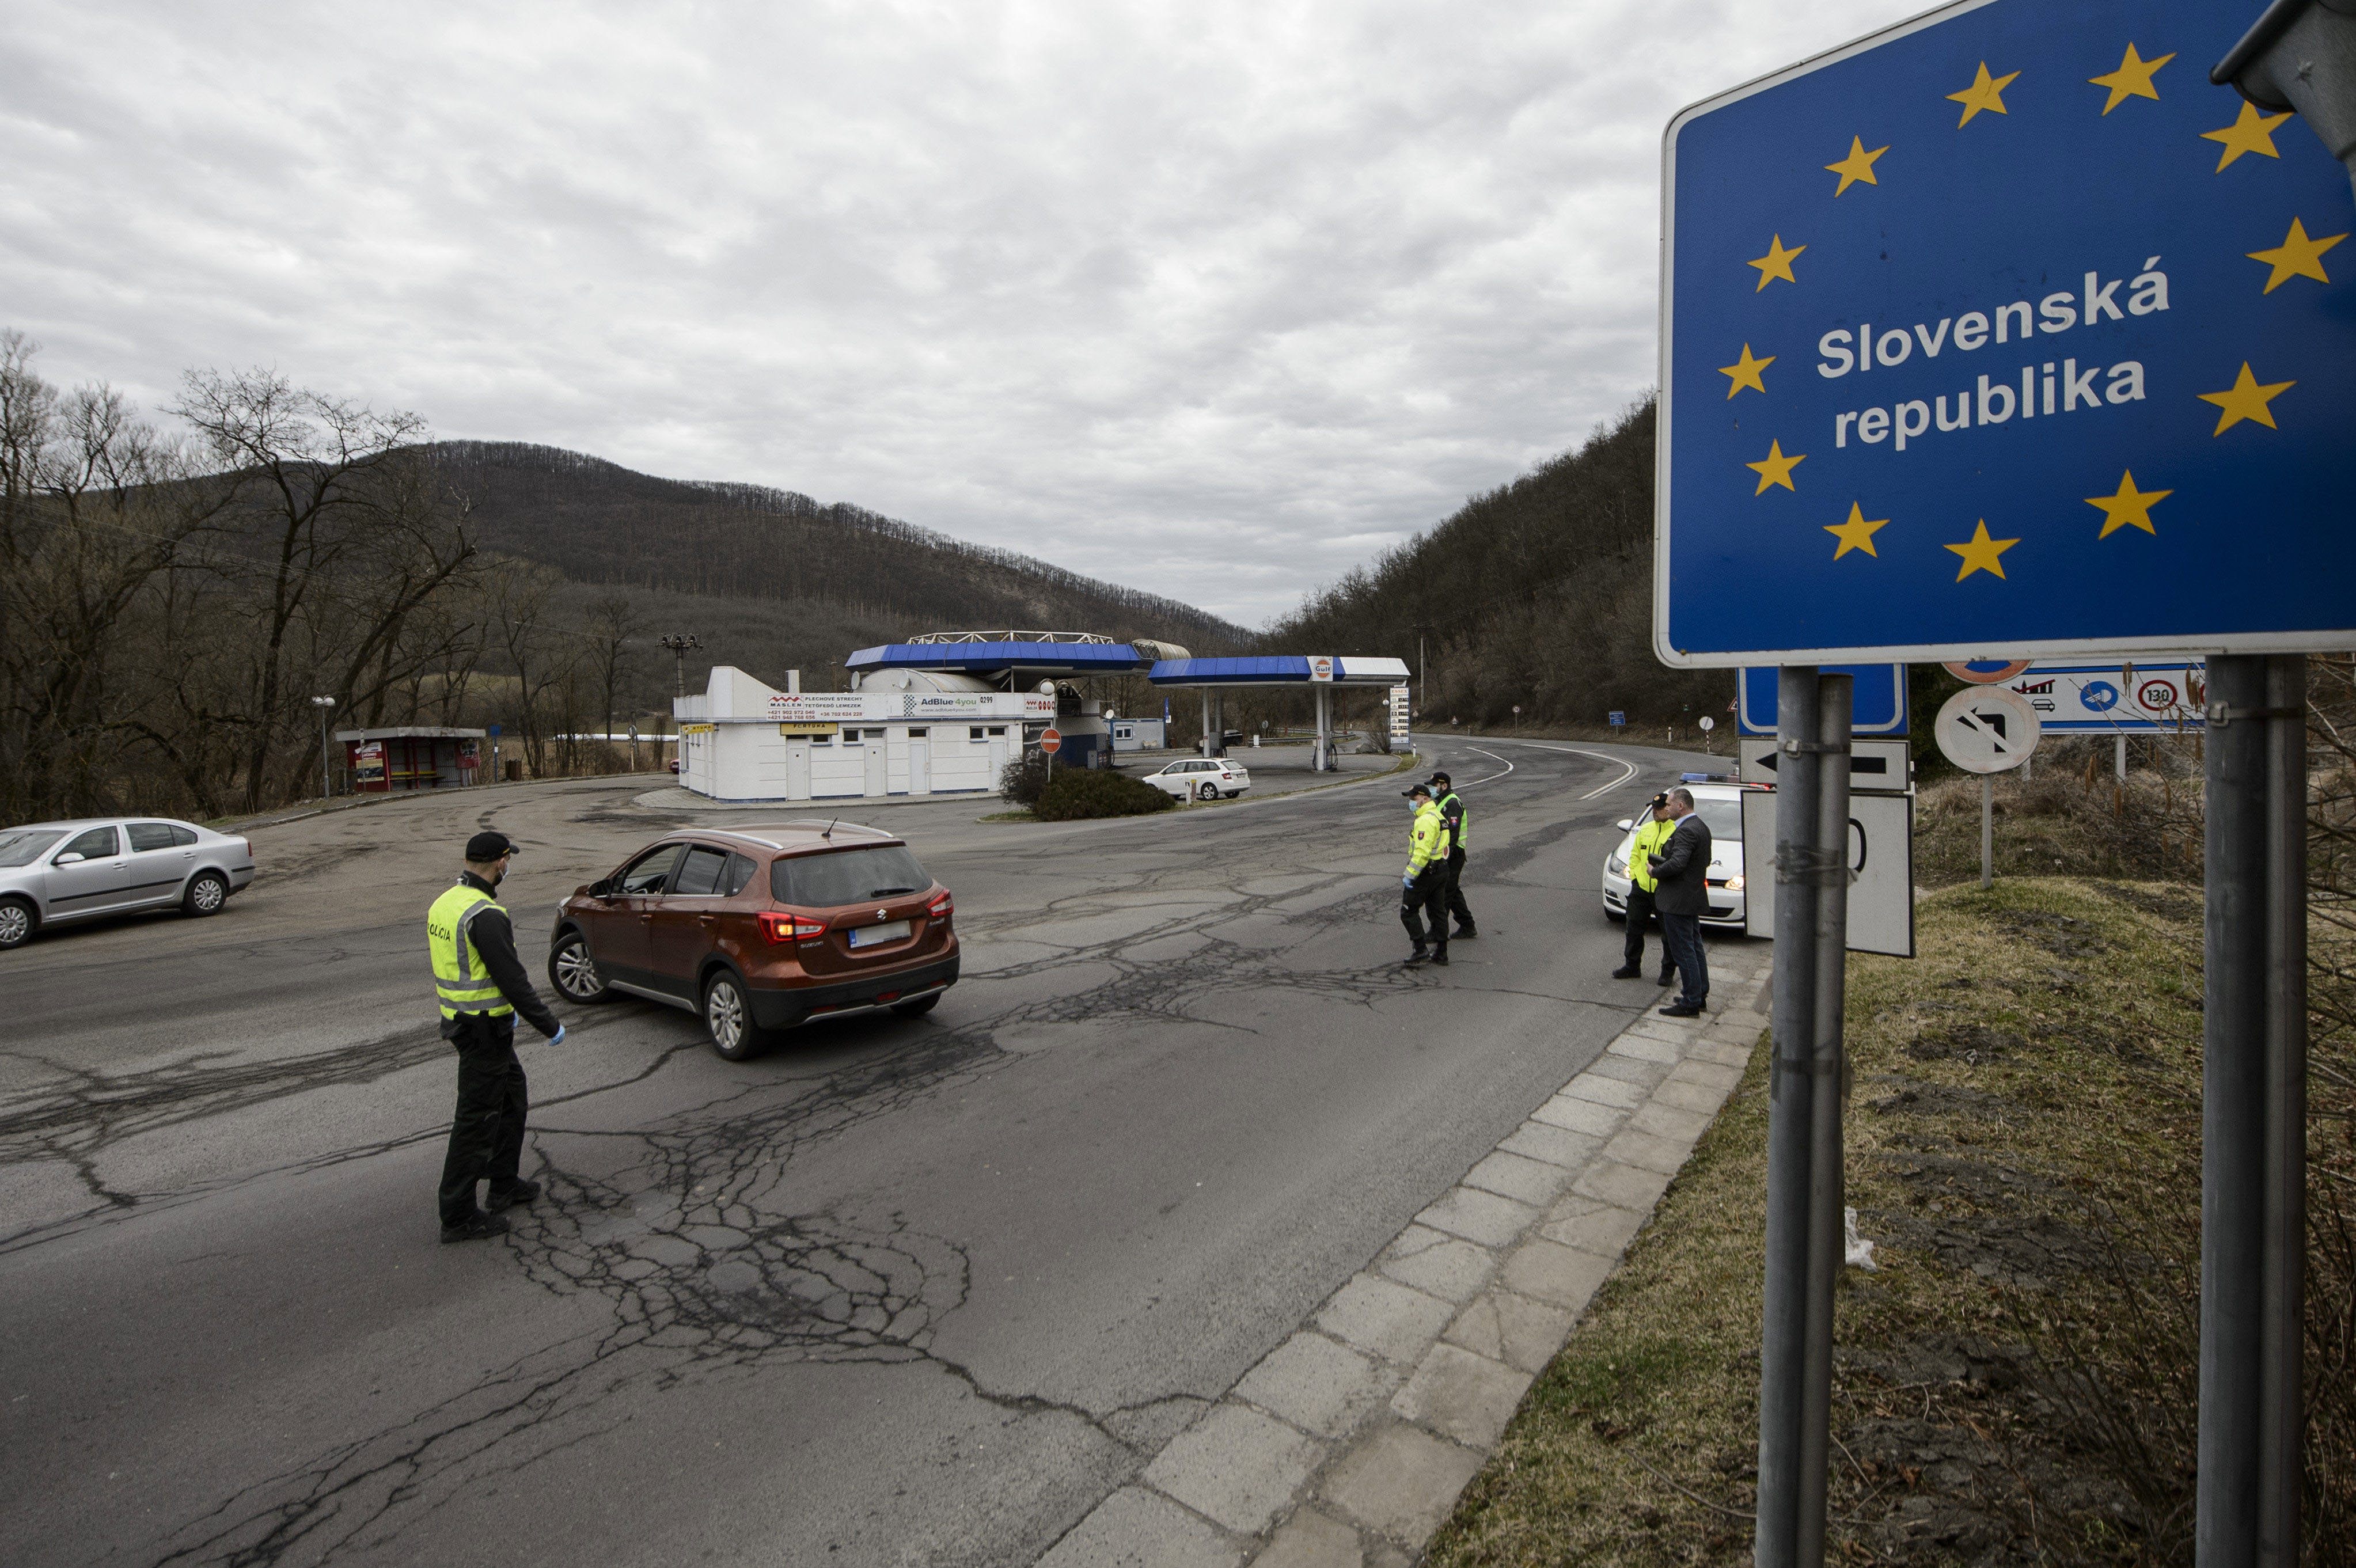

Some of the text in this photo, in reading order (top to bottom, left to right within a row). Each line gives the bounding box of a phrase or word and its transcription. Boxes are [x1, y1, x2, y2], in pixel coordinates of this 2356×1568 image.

[1817, 255, 2170, 379] Slovenská
[1836, 358, 2146, 451] republika
[955, 698, 977, 707] 4you
[2147, 688, 2169, 701] 130
